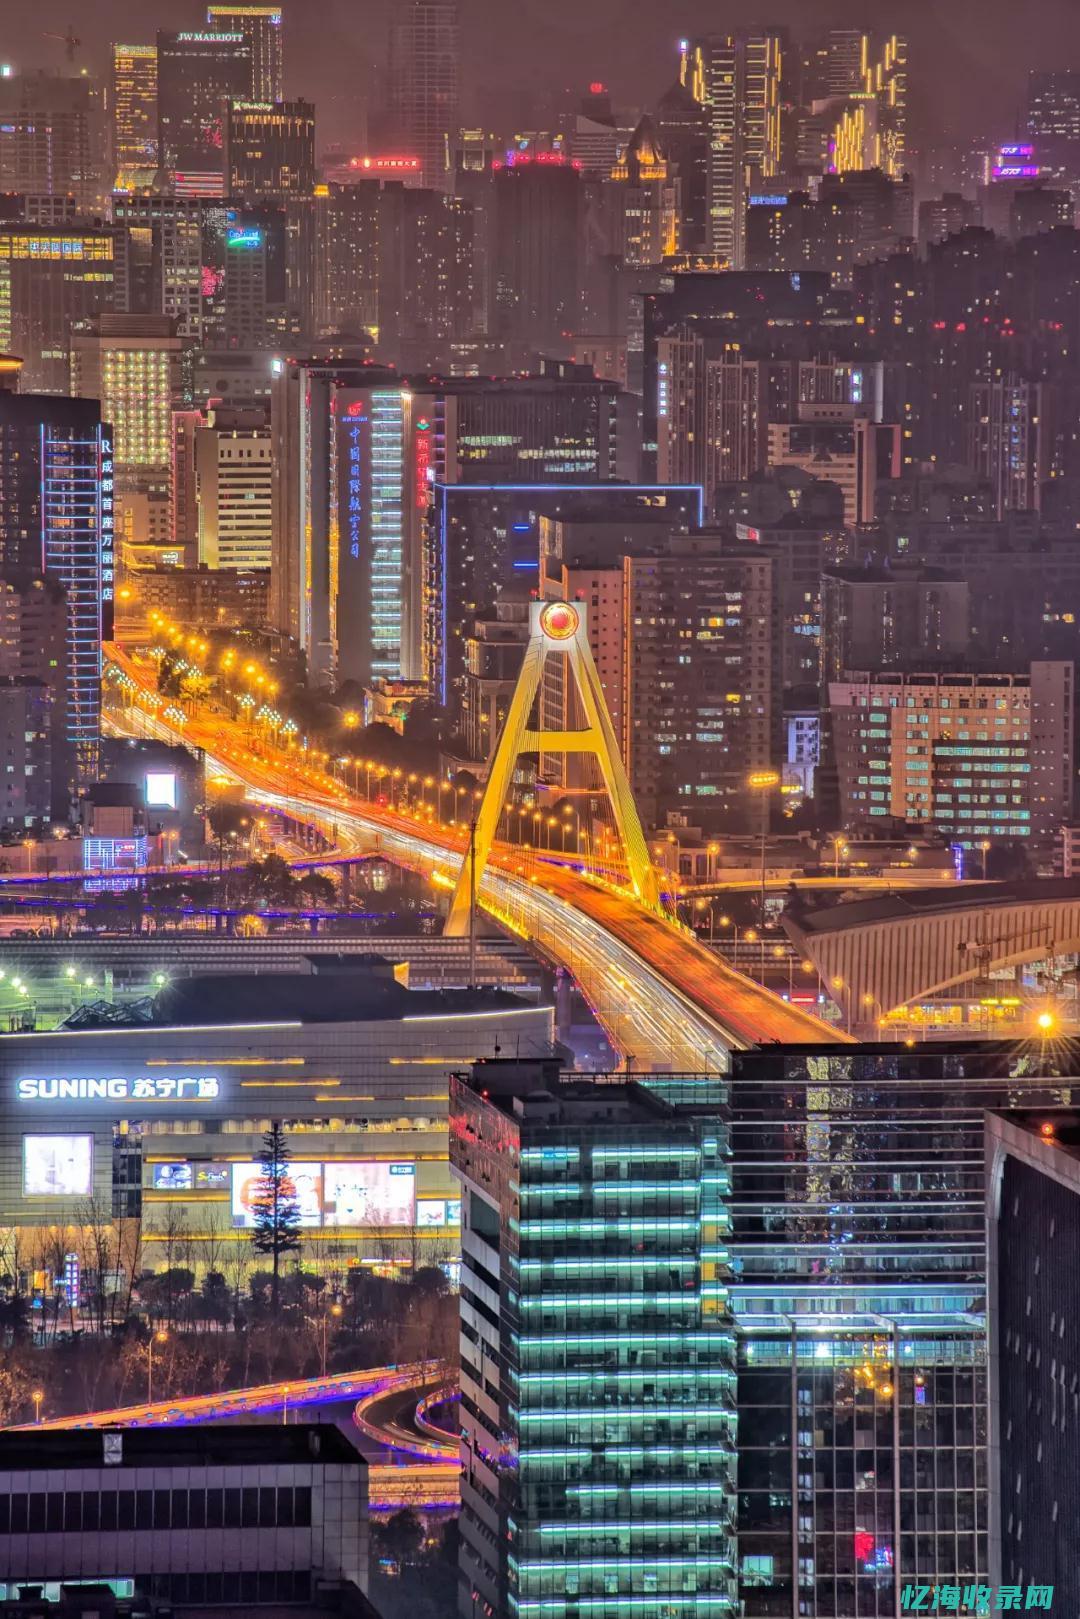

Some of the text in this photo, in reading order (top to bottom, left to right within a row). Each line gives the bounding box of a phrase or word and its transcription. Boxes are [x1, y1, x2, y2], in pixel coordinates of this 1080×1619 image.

[177, 32, 244, 42] JW MARRIOTT
[101, 461, 113, 600] 成都首座万丽酒店
[18, 1078, 128, 1099] SUNING
[131, 1077, 219, 1098] 苏宁广场
